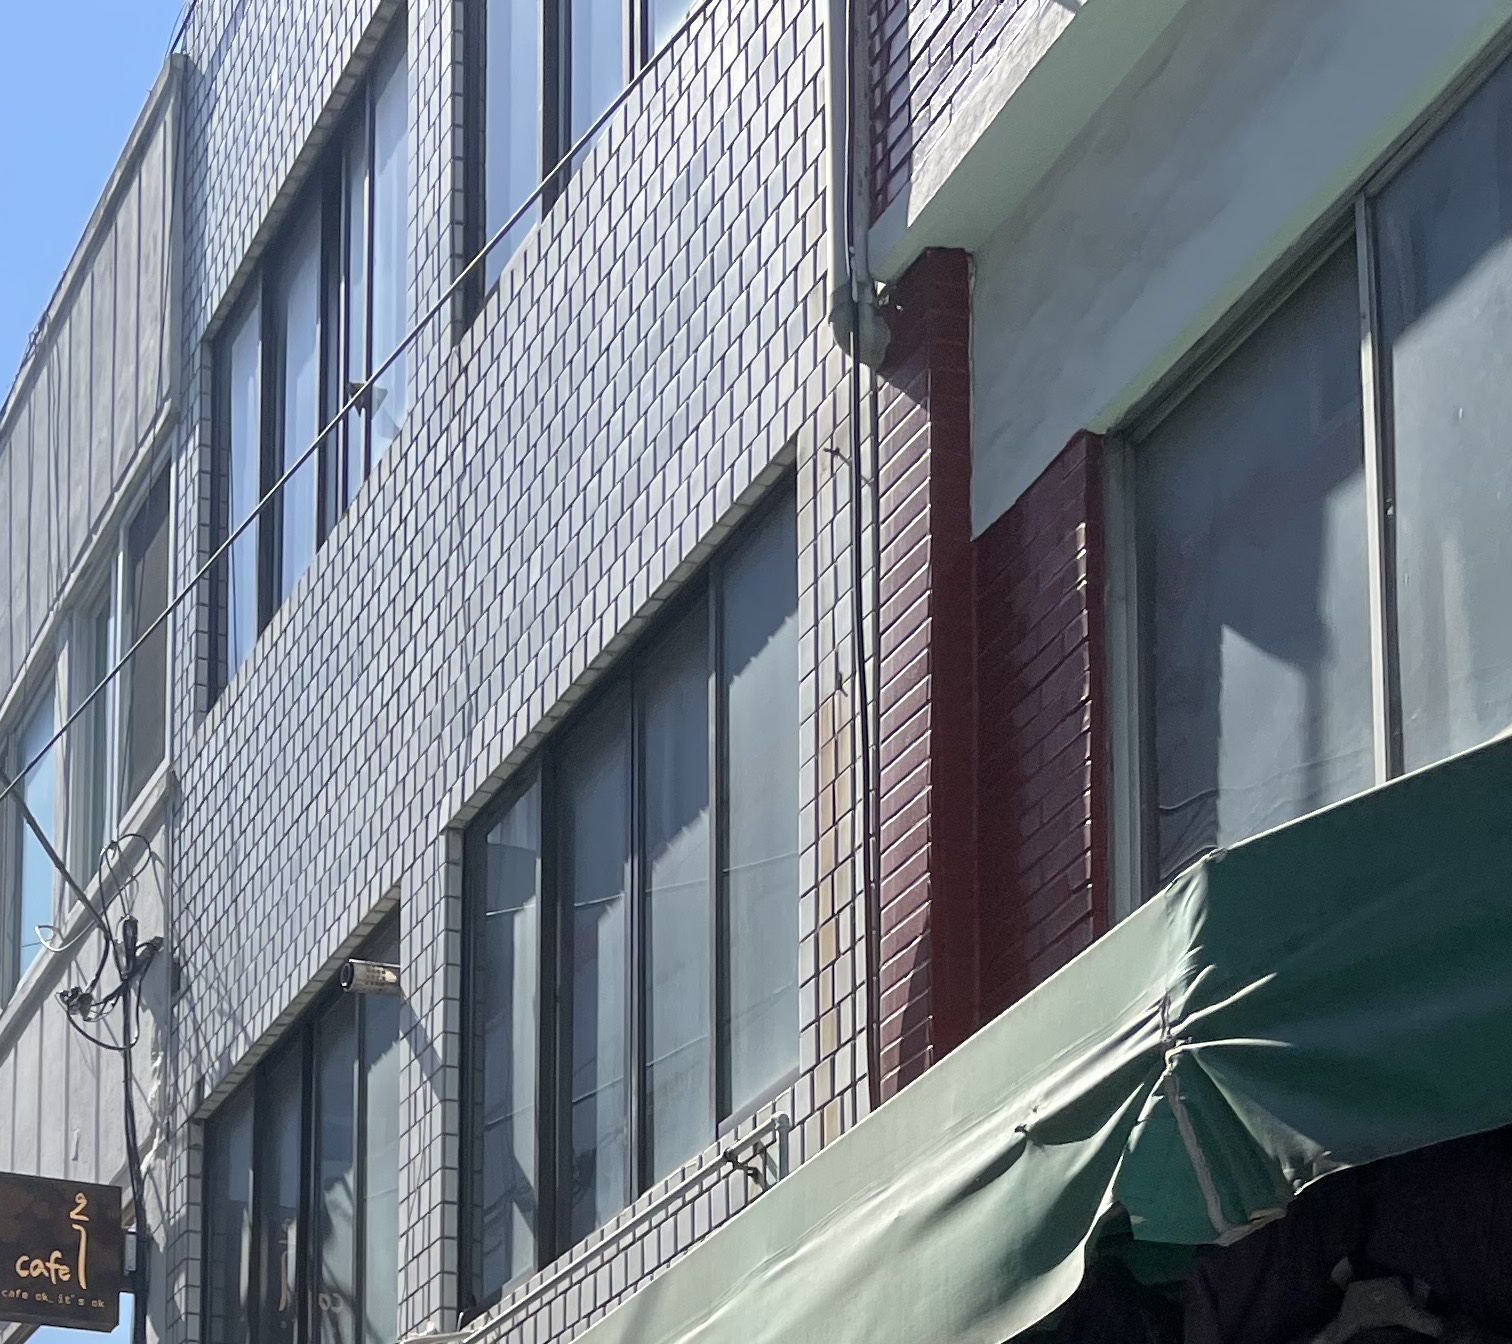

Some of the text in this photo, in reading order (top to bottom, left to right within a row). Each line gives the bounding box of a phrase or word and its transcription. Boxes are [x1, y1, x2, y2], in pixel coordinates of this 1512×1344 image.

[15, 1249, 71, 1285] cafe
[1, 1288, 29, 1300] cafe
[91, 1296, 105, 1308] ok
